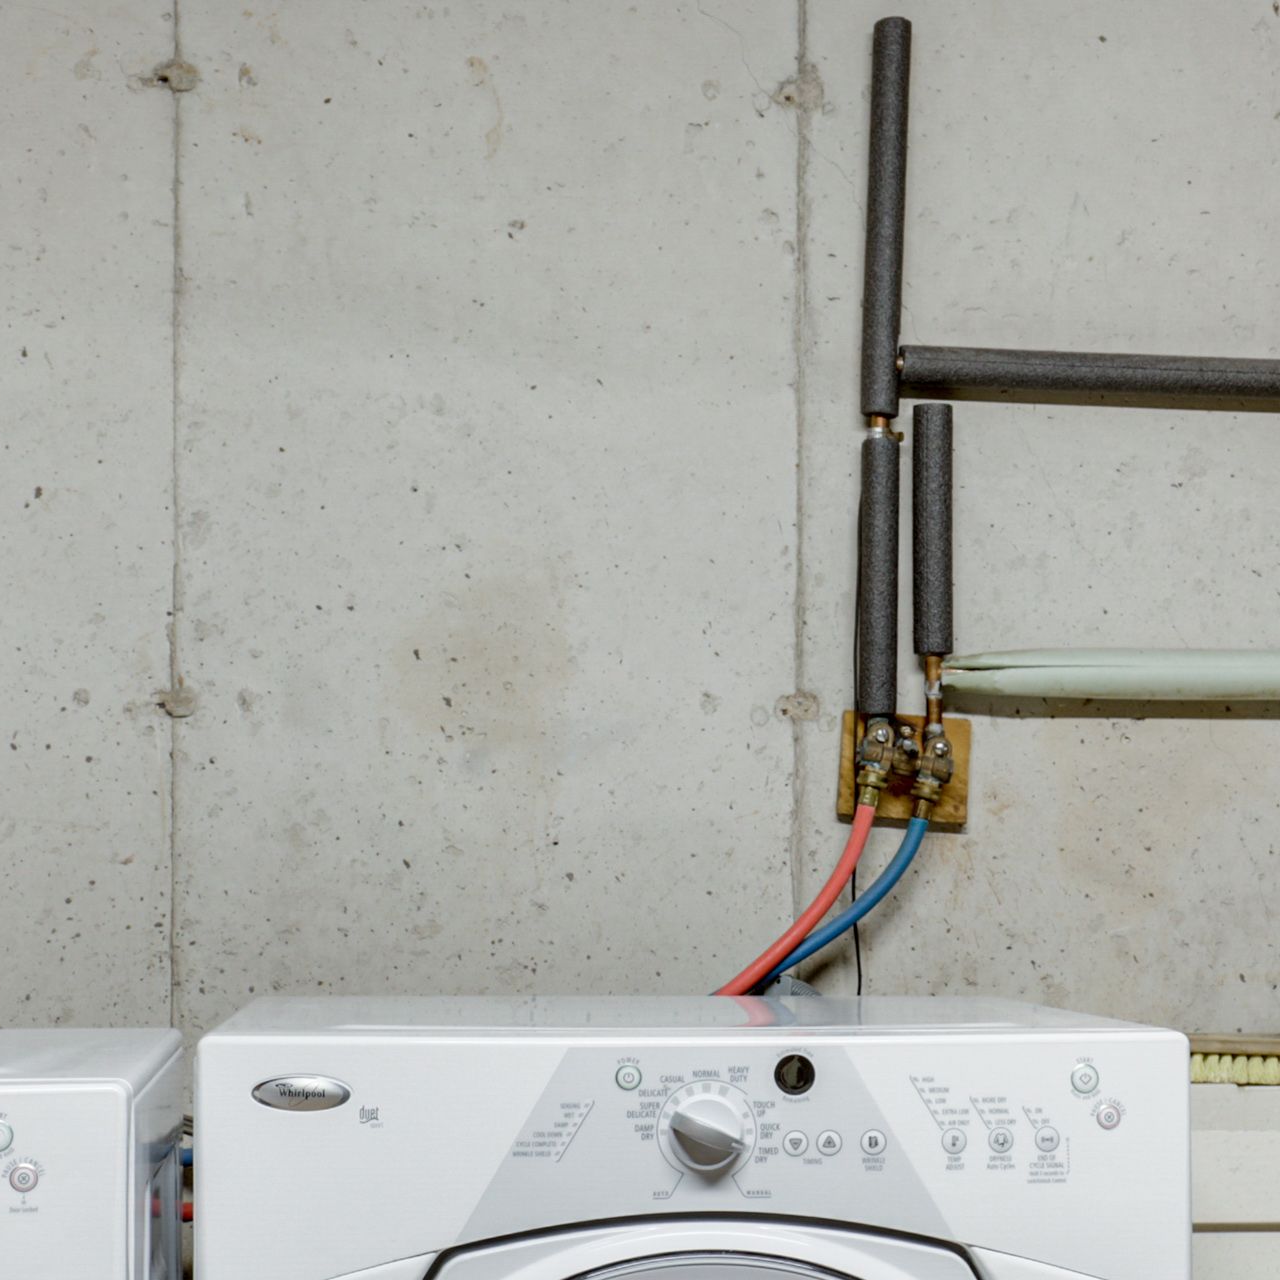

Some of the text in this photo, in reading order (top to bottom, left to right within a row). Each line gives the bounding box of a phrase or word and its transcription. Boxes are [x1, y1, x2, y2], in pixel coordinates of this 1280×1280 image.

[692, 1070, 720, 1078] NORMAL
[728, 1066, 749, 1074] HEAVY
[660, 1075, 685, 1083] CASUAL
[730, 1075, 748, 1083] DUTY
[278, 1088, 326, 1100] Whirlpool
[640, 1102, 660, 1110] SUPER
[753, 1101, 776, 1109] TOUCH
[359, 1105, 380, 1121] duet
[626, 1110, 657, 1119] DELICATE
[757, 1110, 766, 1118] UP
[634, 1124, 654, 1132] DAMP
[760, 1123, 780, 1131] QUICK
[641, 1133, 654, 1141] DRY
[760, 1132, 773, 1140] DRY
[758, 1147, 779, 1155] TIMED
[755, 1156, 768, 1164] DRY
